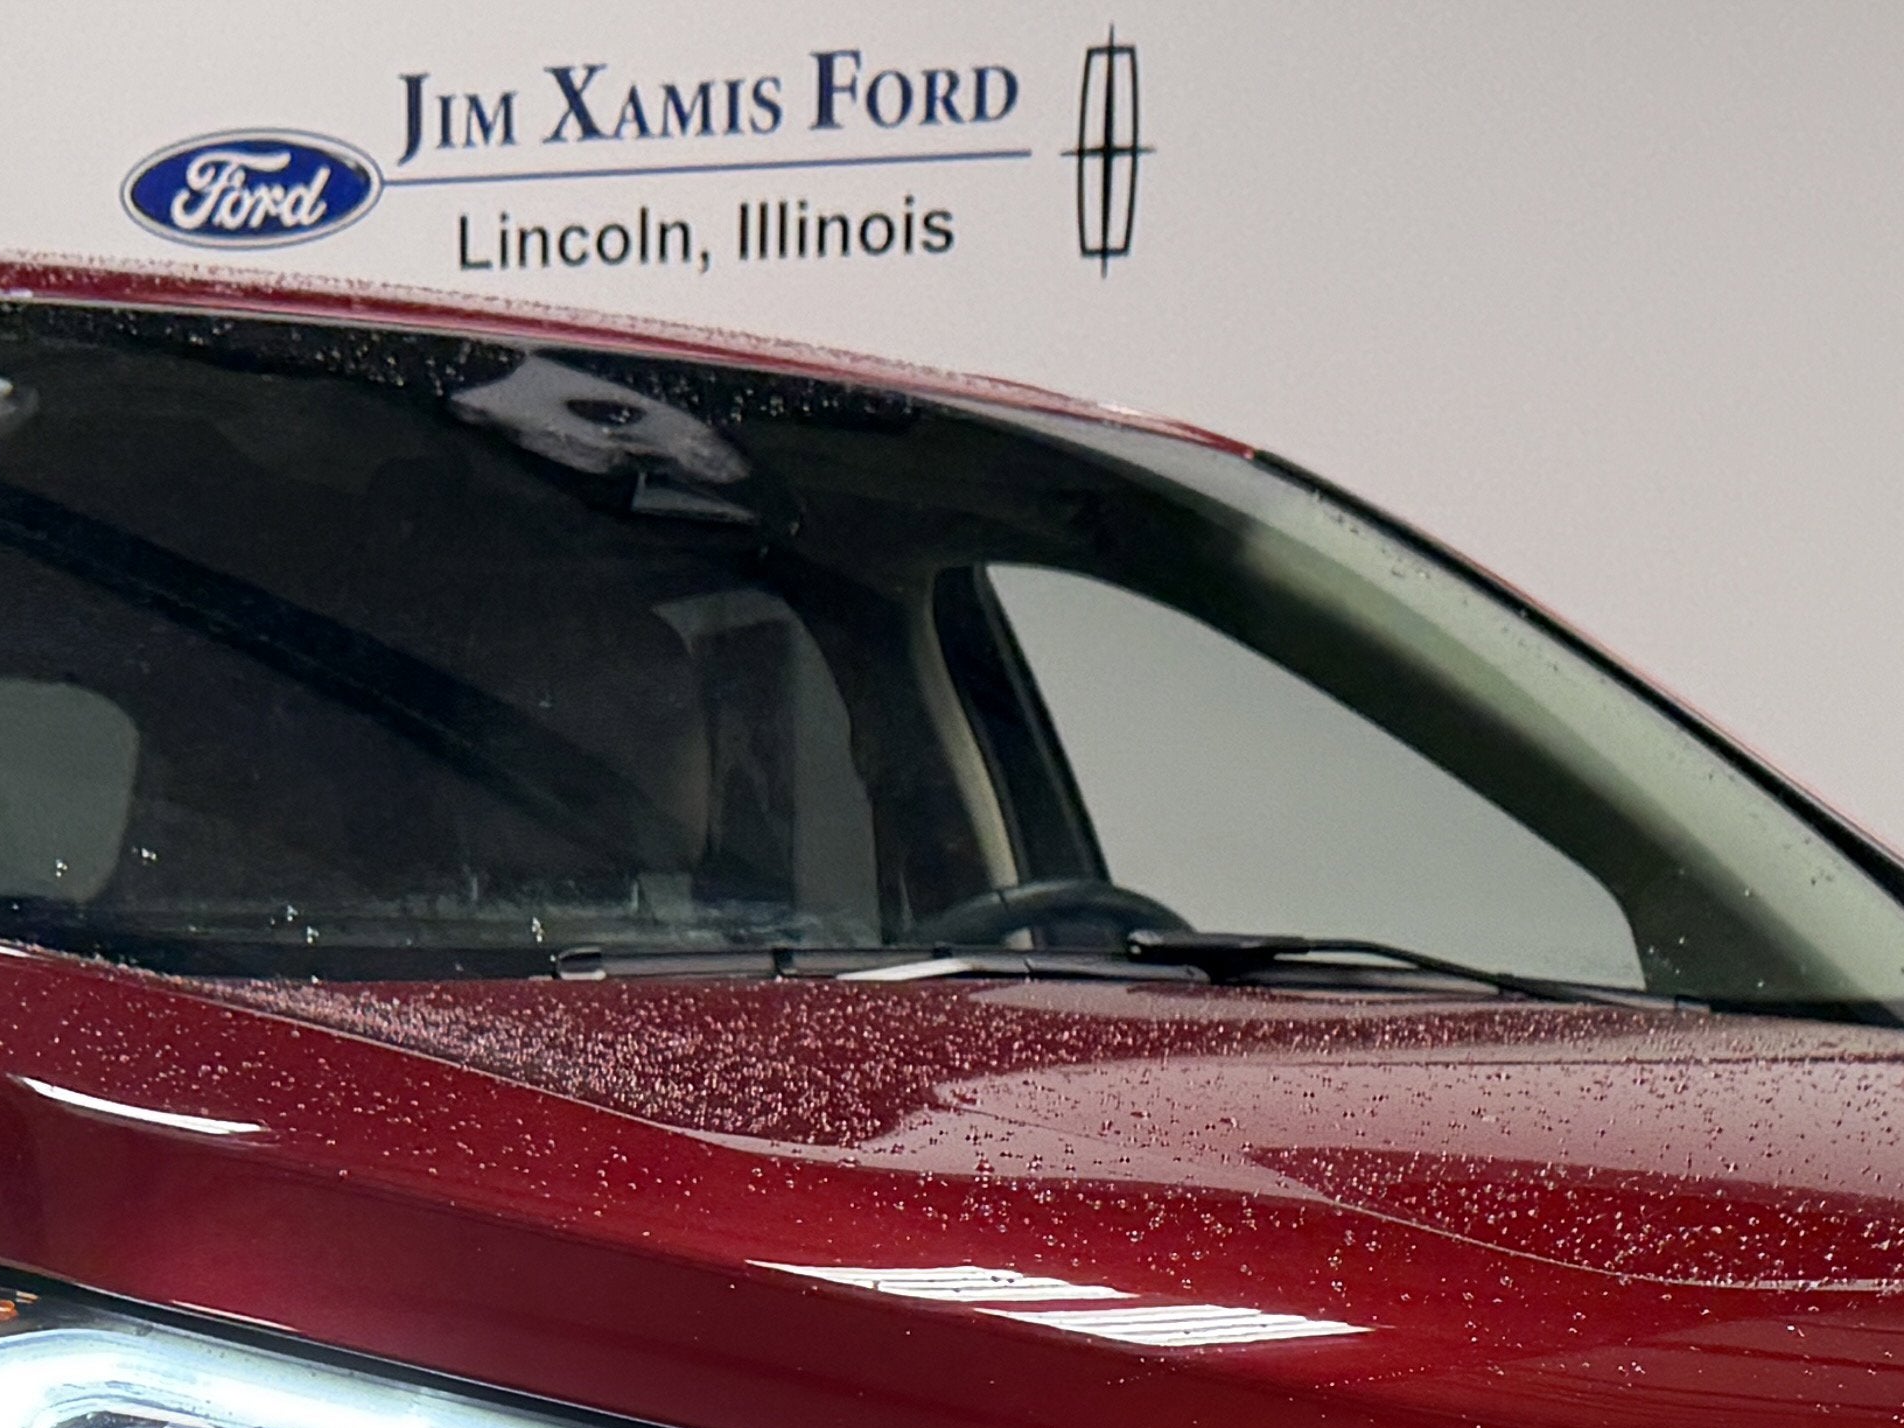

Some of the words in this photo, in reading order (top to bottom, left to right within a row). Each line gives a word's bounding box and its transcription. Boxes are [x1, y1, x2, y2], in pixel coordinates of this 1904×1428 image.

[171, 150, 332, 231] Ford
[458, 206, 712, 276] Lincoln,
[738, 194, 956, 261] Illinois
